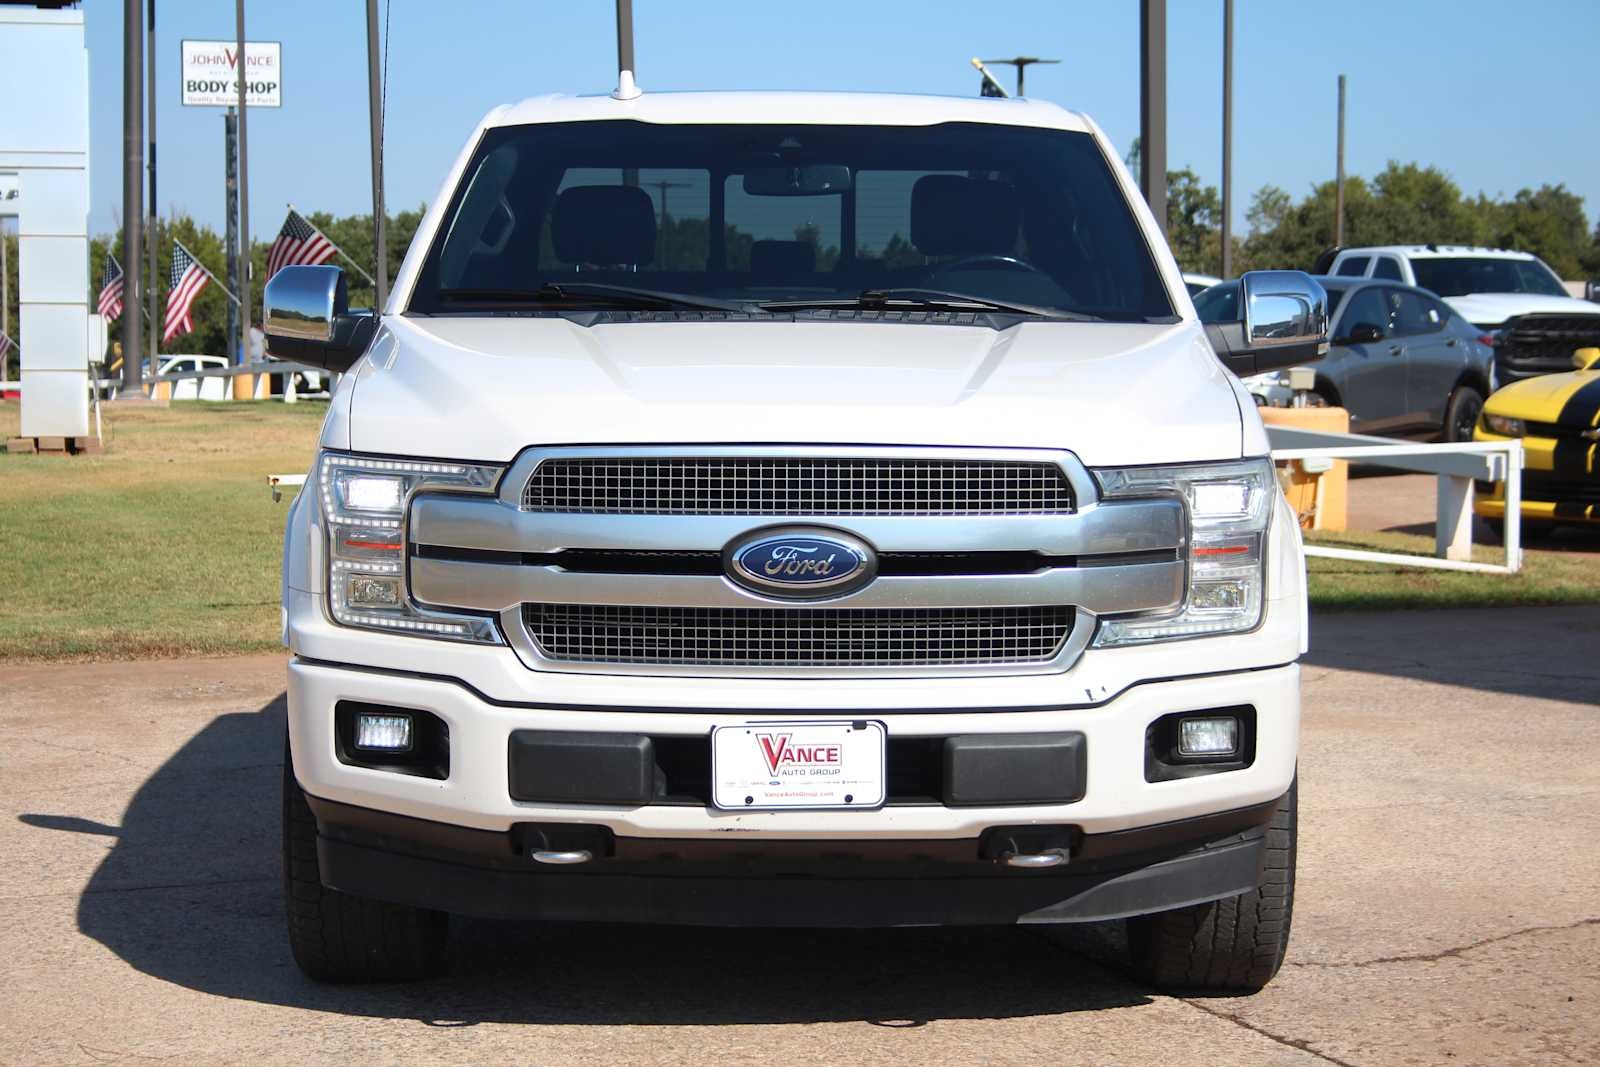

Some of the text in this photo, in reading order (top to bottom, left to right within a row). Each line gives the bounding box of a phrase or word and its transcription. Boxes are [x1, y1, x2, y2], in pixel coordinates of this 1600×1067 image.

[225, 48, 274, 70] VNCE
[187, 80, 228, 93] BODY
[764, 545, 835, 576] Ford
[760, 736, 838, 773] VANCE
